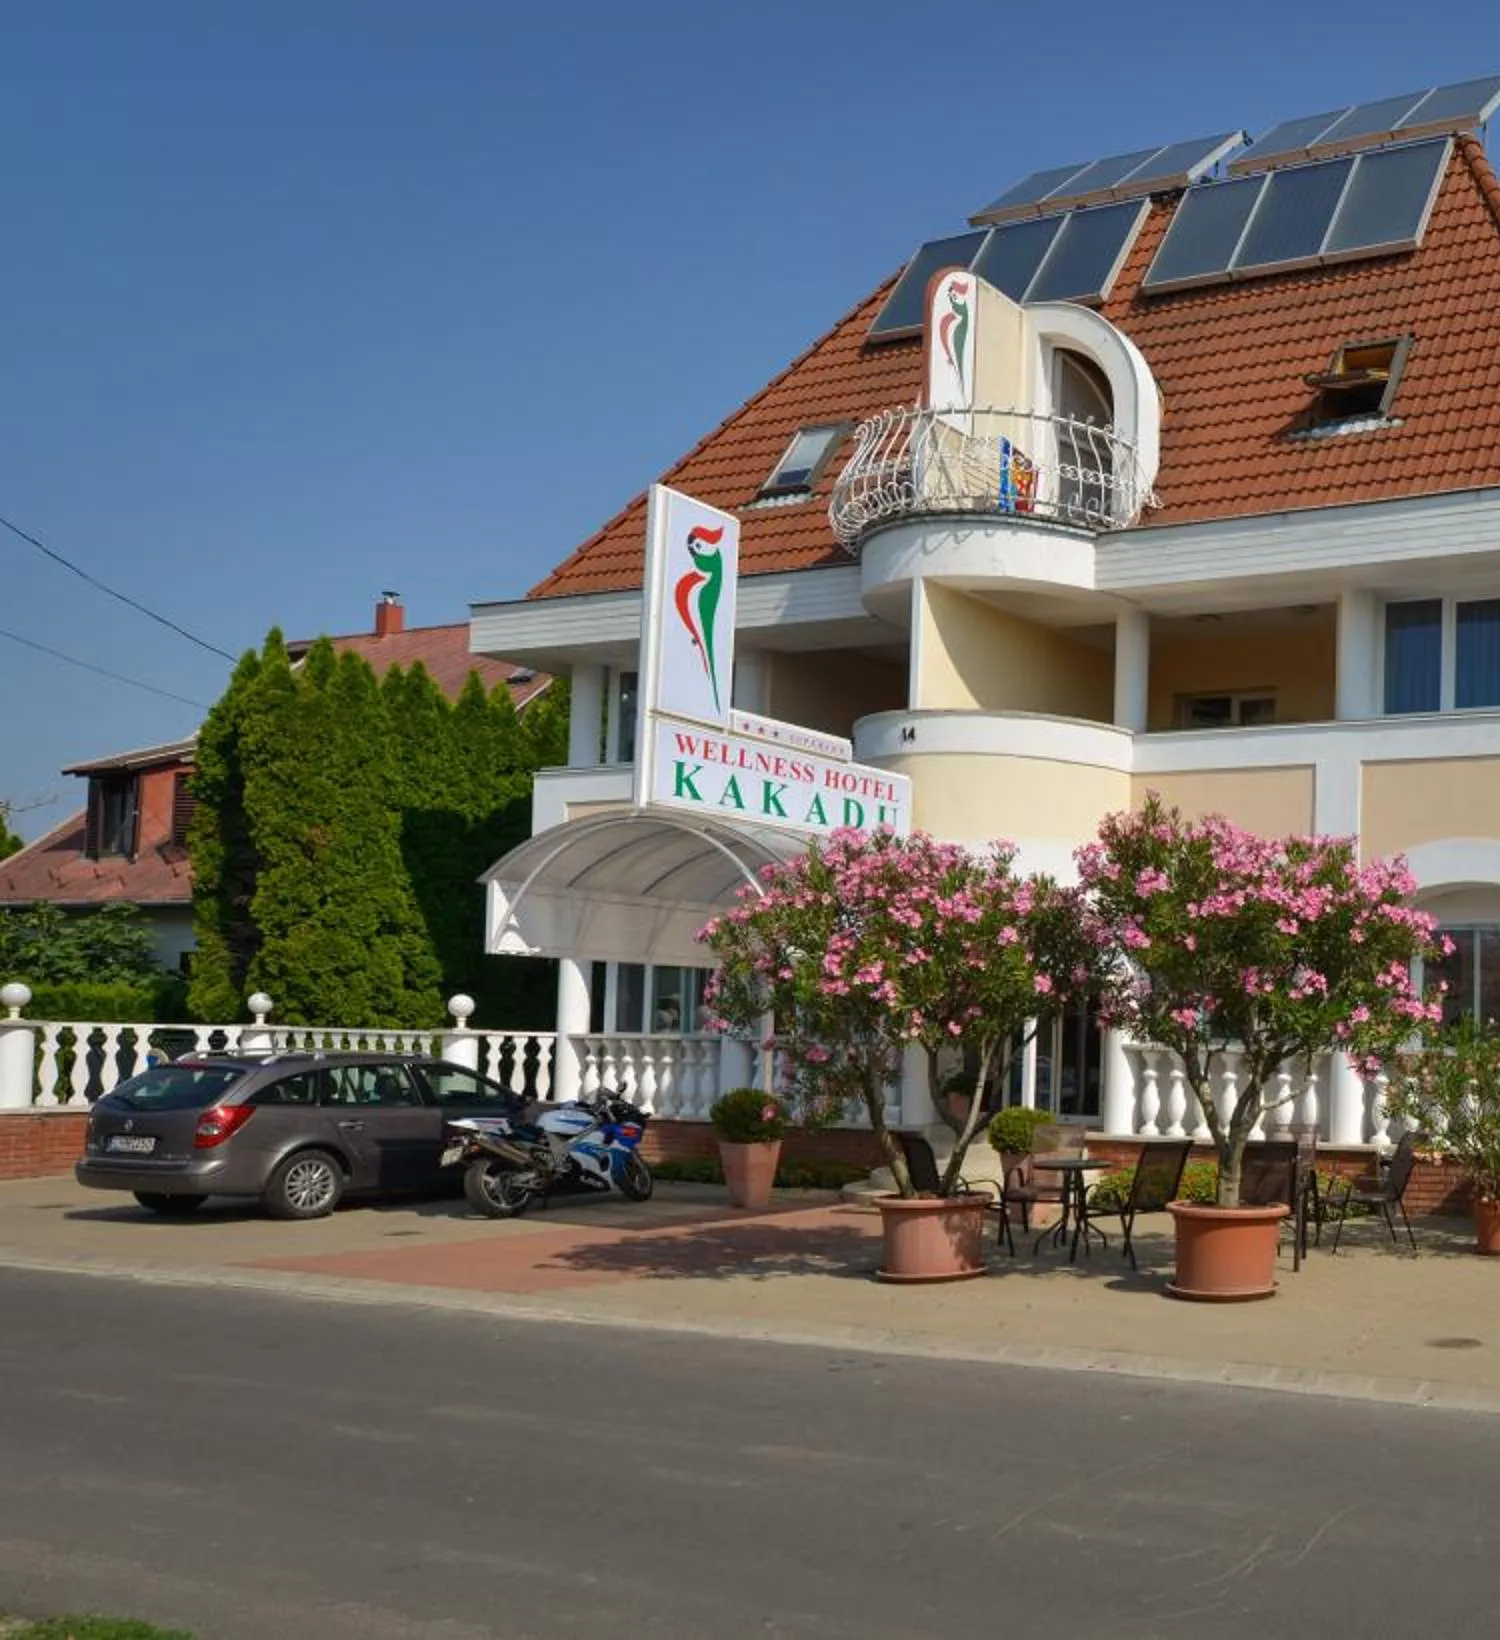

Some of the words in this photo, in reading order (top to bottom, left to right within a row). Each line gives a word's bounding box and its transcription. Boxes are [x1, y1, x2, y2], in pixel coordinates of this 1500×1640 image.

[902, 727, 915, 741] 14
[674, 733, 815, 783] WELLNESS
[825, 768, 899, 803] HOTEL
